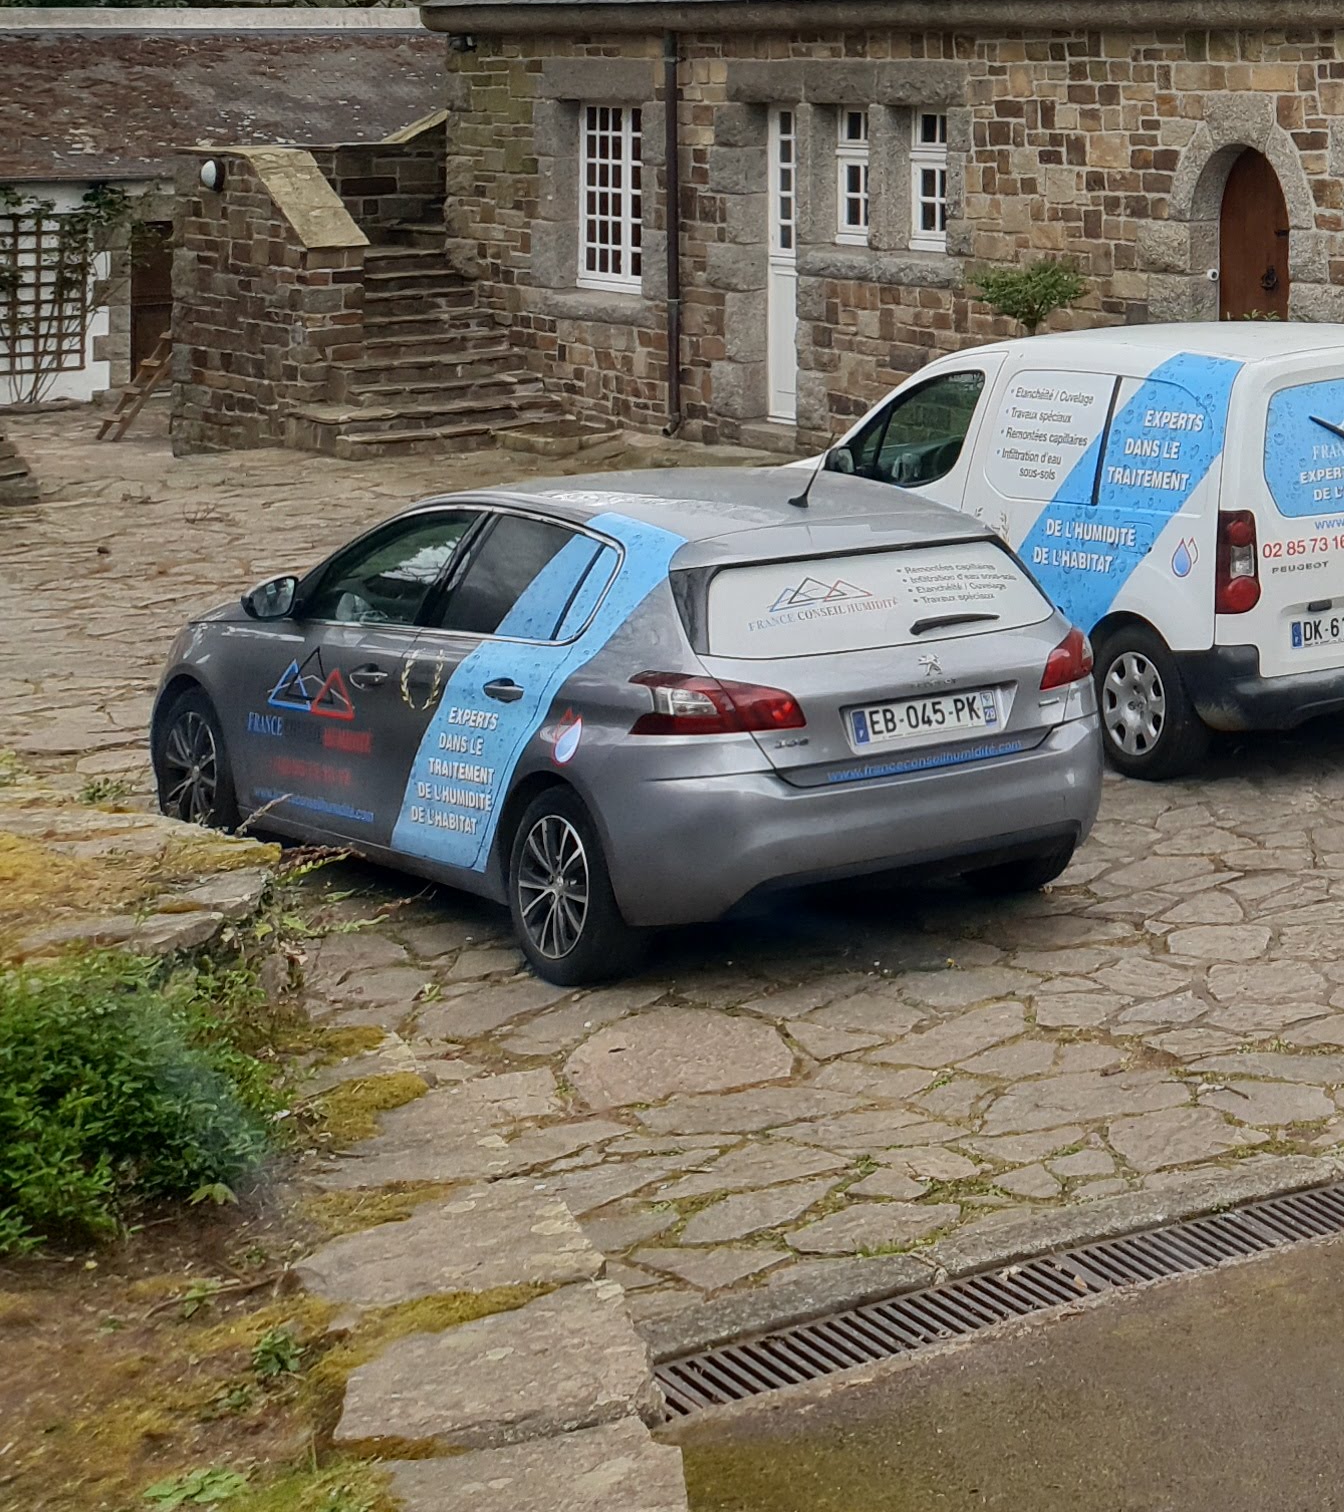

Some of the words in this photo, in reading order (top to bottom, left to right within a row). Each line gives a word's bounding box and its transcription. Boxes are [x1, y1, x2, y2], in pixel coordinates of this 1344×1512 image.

[1060, 391, 1094, 406] Cuvelage
[1011, 407, 1037, 419] Travaux
[1039, 410, 1072, 423] spéciaux
[1143, 410, 1204, 432] EXPERTS
[1006, 427, 1047, 442] Remontées
[1049, 432, 1088, 446] capillaires
[1002, 448, 1039, 462] Infiltration
[1124, 438, 1159, 459] DANS
[1162, 442, 1181, 461] LE
[1019, 467, 1056, 480] sous-sols
[1107, 466, 1191, 491] TRAITEMENT
[1314, 488, 1331, 502] DE
[1046, 518, 1062, 538] DE
[1064, 520, 1136, 547] L'HUMIDITÉ
[1262, 542, 1282, 558] 02
[1286, 540, 1306, 556] 85
[1310, 537, 1328, 553] 73
[1033, 546, 1049, 565] DE
[1052, 548, 1114, 574] L'HABITAT
[1272, 560, 1329, 574] PEUGEOT
[748, 614, 796, 632] FRANCE
[797, 605, 847, 621] CONSEIL
[248, 712, 283, 736] FRANCE
[448, 707, 499, 730] EXPERTS
[868, 695, 981, 736] EB-045-PK
[438, 732, 468, 754] DANS
[470, 737, 484, 756] LE
[428, 758, 496, 787] TRAITEMENT
[417, 782, 432, 799] DE
[434, 784, 492, 812] L'HUMIDITÉ
[411, 806, 426, 822] DE
[426, 806, 478, 835] L'HABITAT
